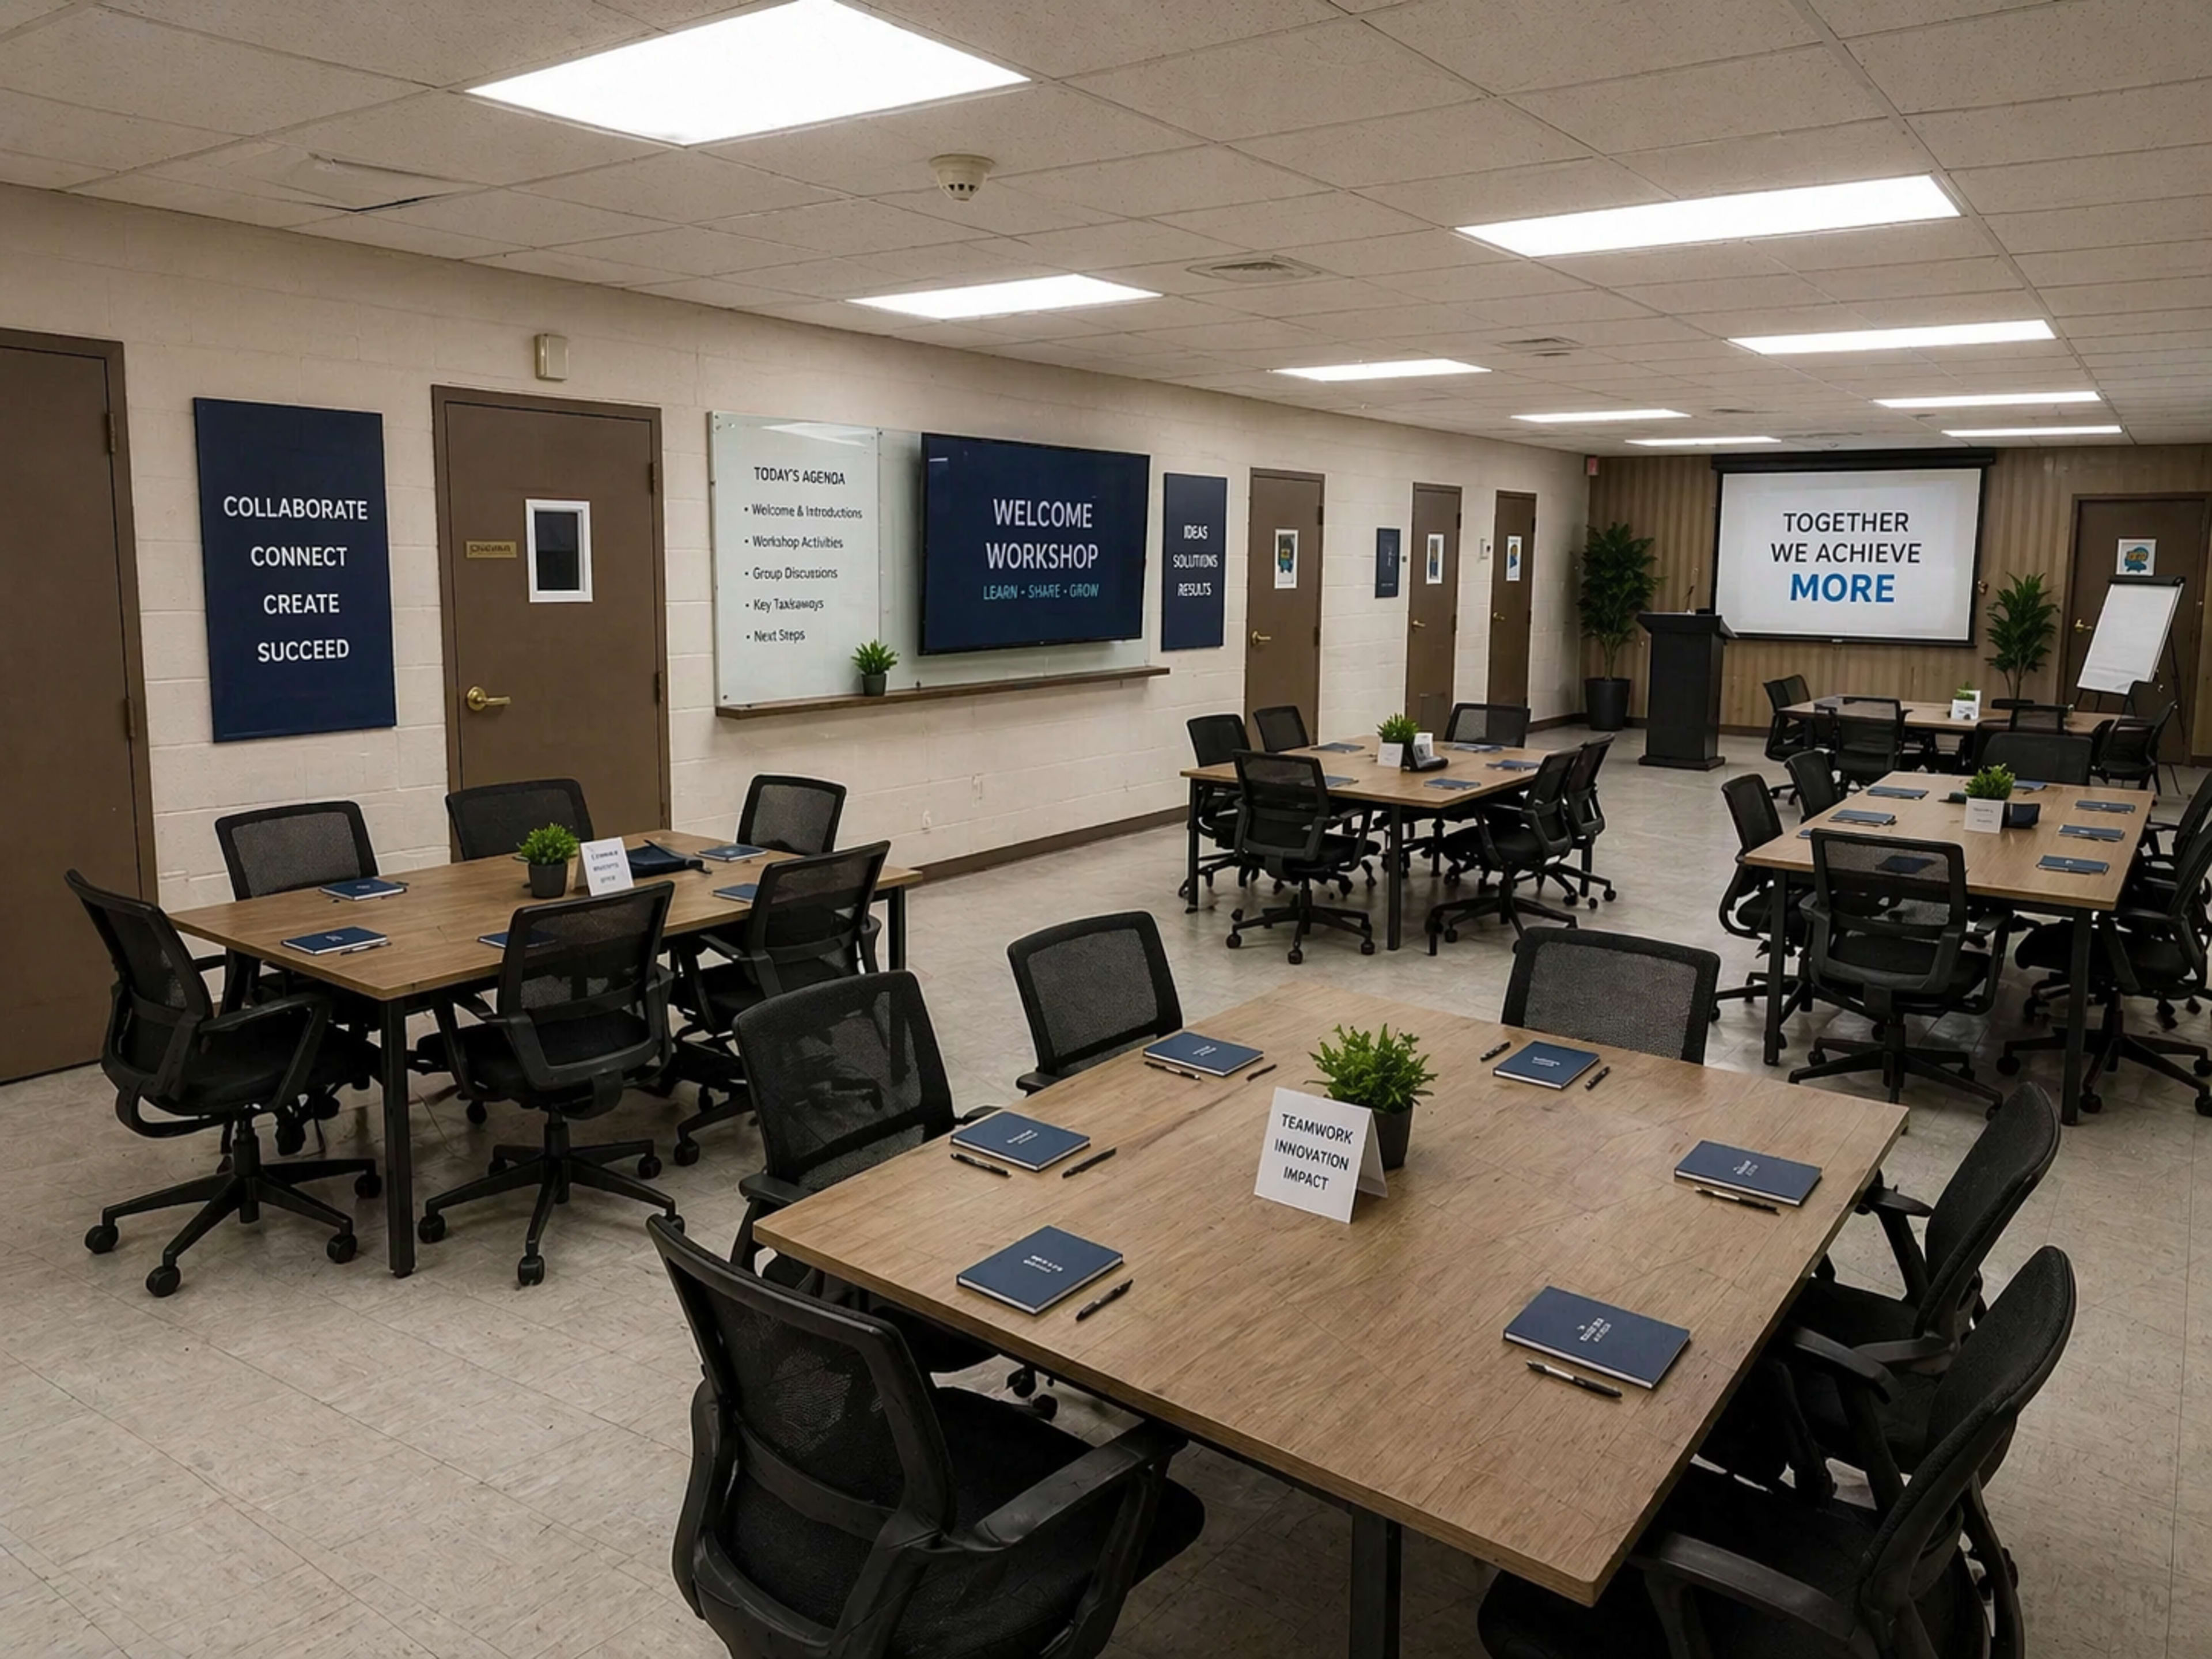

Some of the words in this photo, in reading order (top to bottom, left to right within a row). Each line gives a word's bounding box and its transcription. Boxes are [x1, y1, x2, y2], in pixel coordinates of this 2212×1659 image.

[754, 467, 799, 482] TODAY'S
[224, 497, 368, 520] COLLABORATE
[752, 504, 794, 516] Welcome
[797, 505, 804, 517] &
[994, 499, 1092, 528] WELCOME
[1184, 525, 1207, 539] IDEAS
[1783, 513, 1908, 532] TOGETHER
[802, 537, 843, 548] Activities
[251, 547, 347, 566] CONNECT
[986, 543, 1098, 569] WORKSHOP
[1173, 554, 1218, 568] SOLUTIONS
[1771, 543, 1808, 562] WE
[1816, 543, 1921, 563] ACHIEVE
[753, 567, 782, 581] Group
[984, 585, 1017, 600] LEARN
[1029, 584, 1060, 598] SHARE
[1070, 584, 1099, 597] GROW
[1178, 583, 1211, 596] RESULTS
[1791, 574, 1895, 602] MORE
[264, 594, 339, 614] CREATE
[754, 599, 771, 613] Key
[755, 631, 776, 641] Next
[779, 629, 805, 643] Steps
[258, 639, 349, 662] SUCCEED
[1282, 1113, 1354, 1145] TEAMWORK
[1274, 1138, 1350, 1171] INNOVATION
[1284, 1166, 1329, 1190] IMPACT
